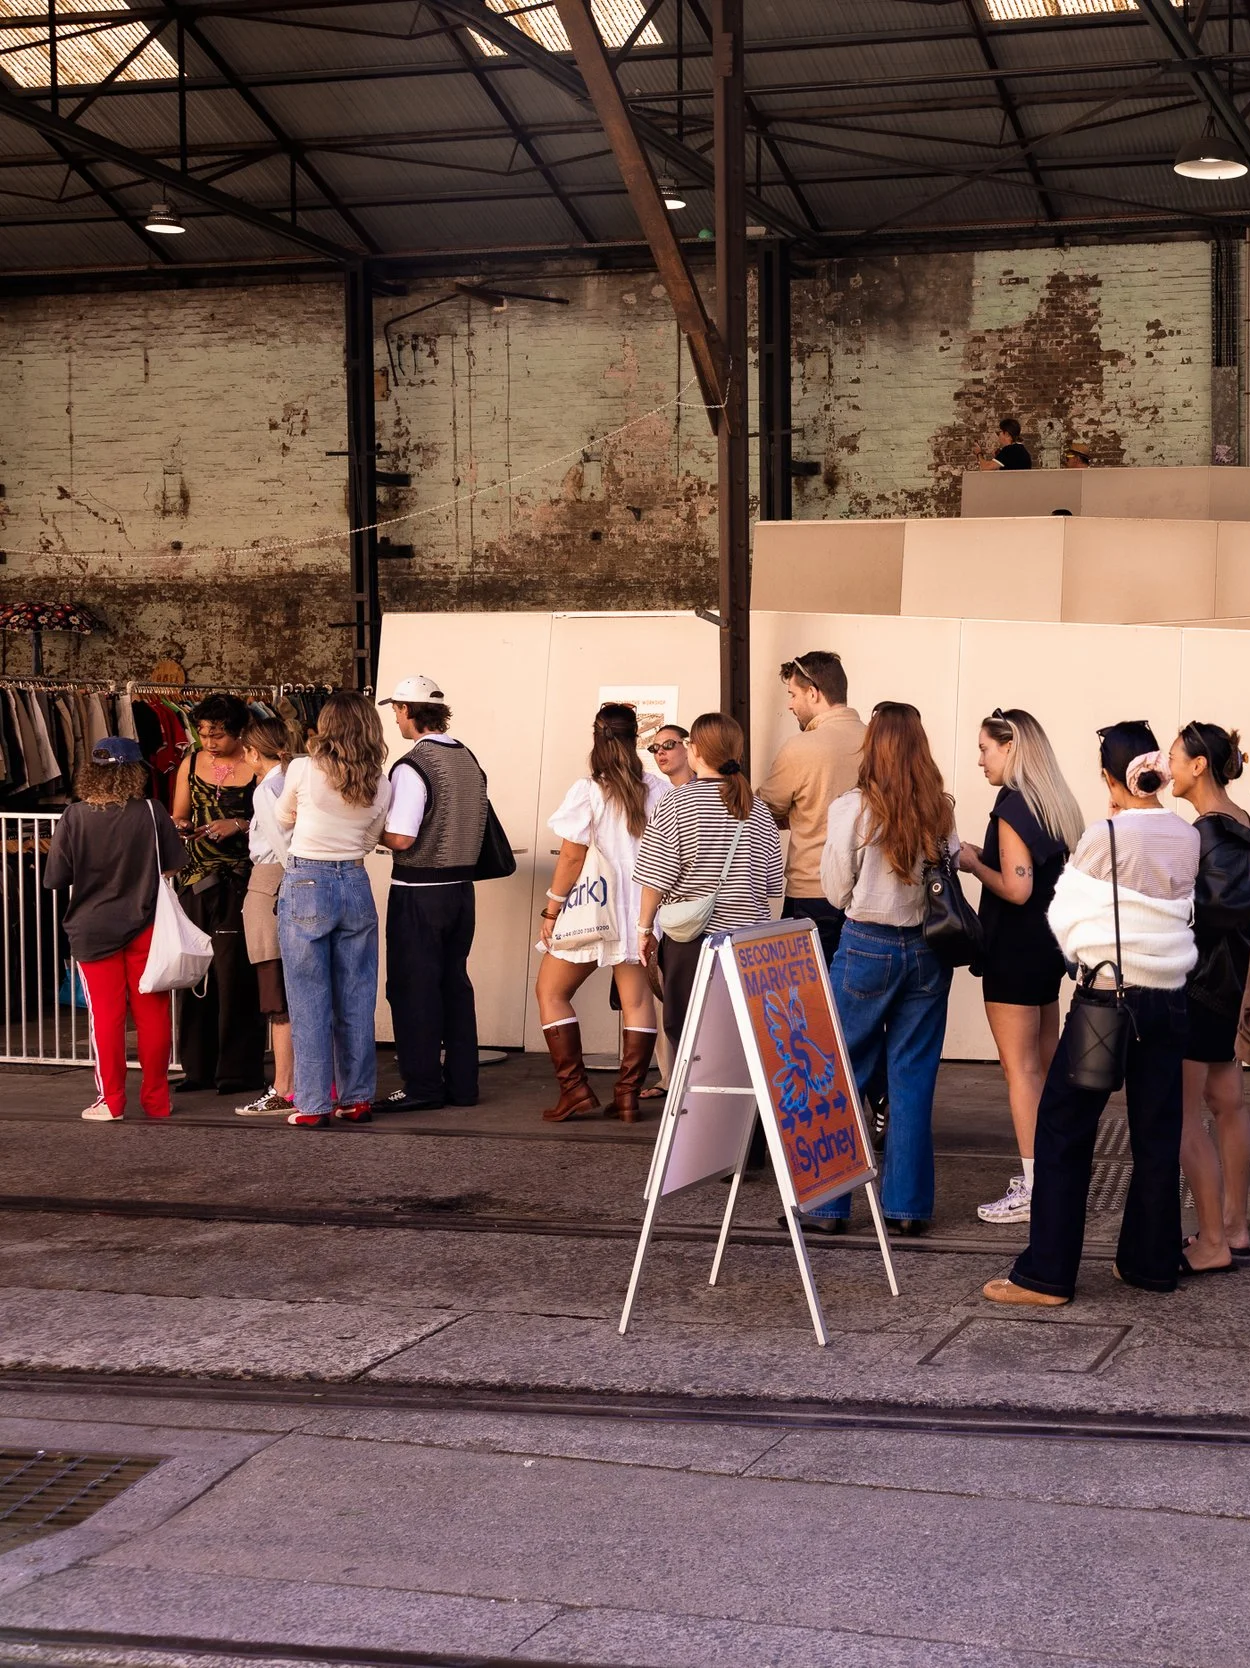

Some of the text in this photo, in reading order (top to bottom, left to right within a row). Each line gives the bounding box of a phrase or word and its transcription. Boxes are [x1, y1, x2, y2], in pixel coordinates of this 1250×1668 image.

[596, 924, 610, 932] 9200
[738, 935, 811, 968] SECOND LIFE
[743, 957, 818, 998] MARKETS
[795, 1124, 857, 1179] Sydney
